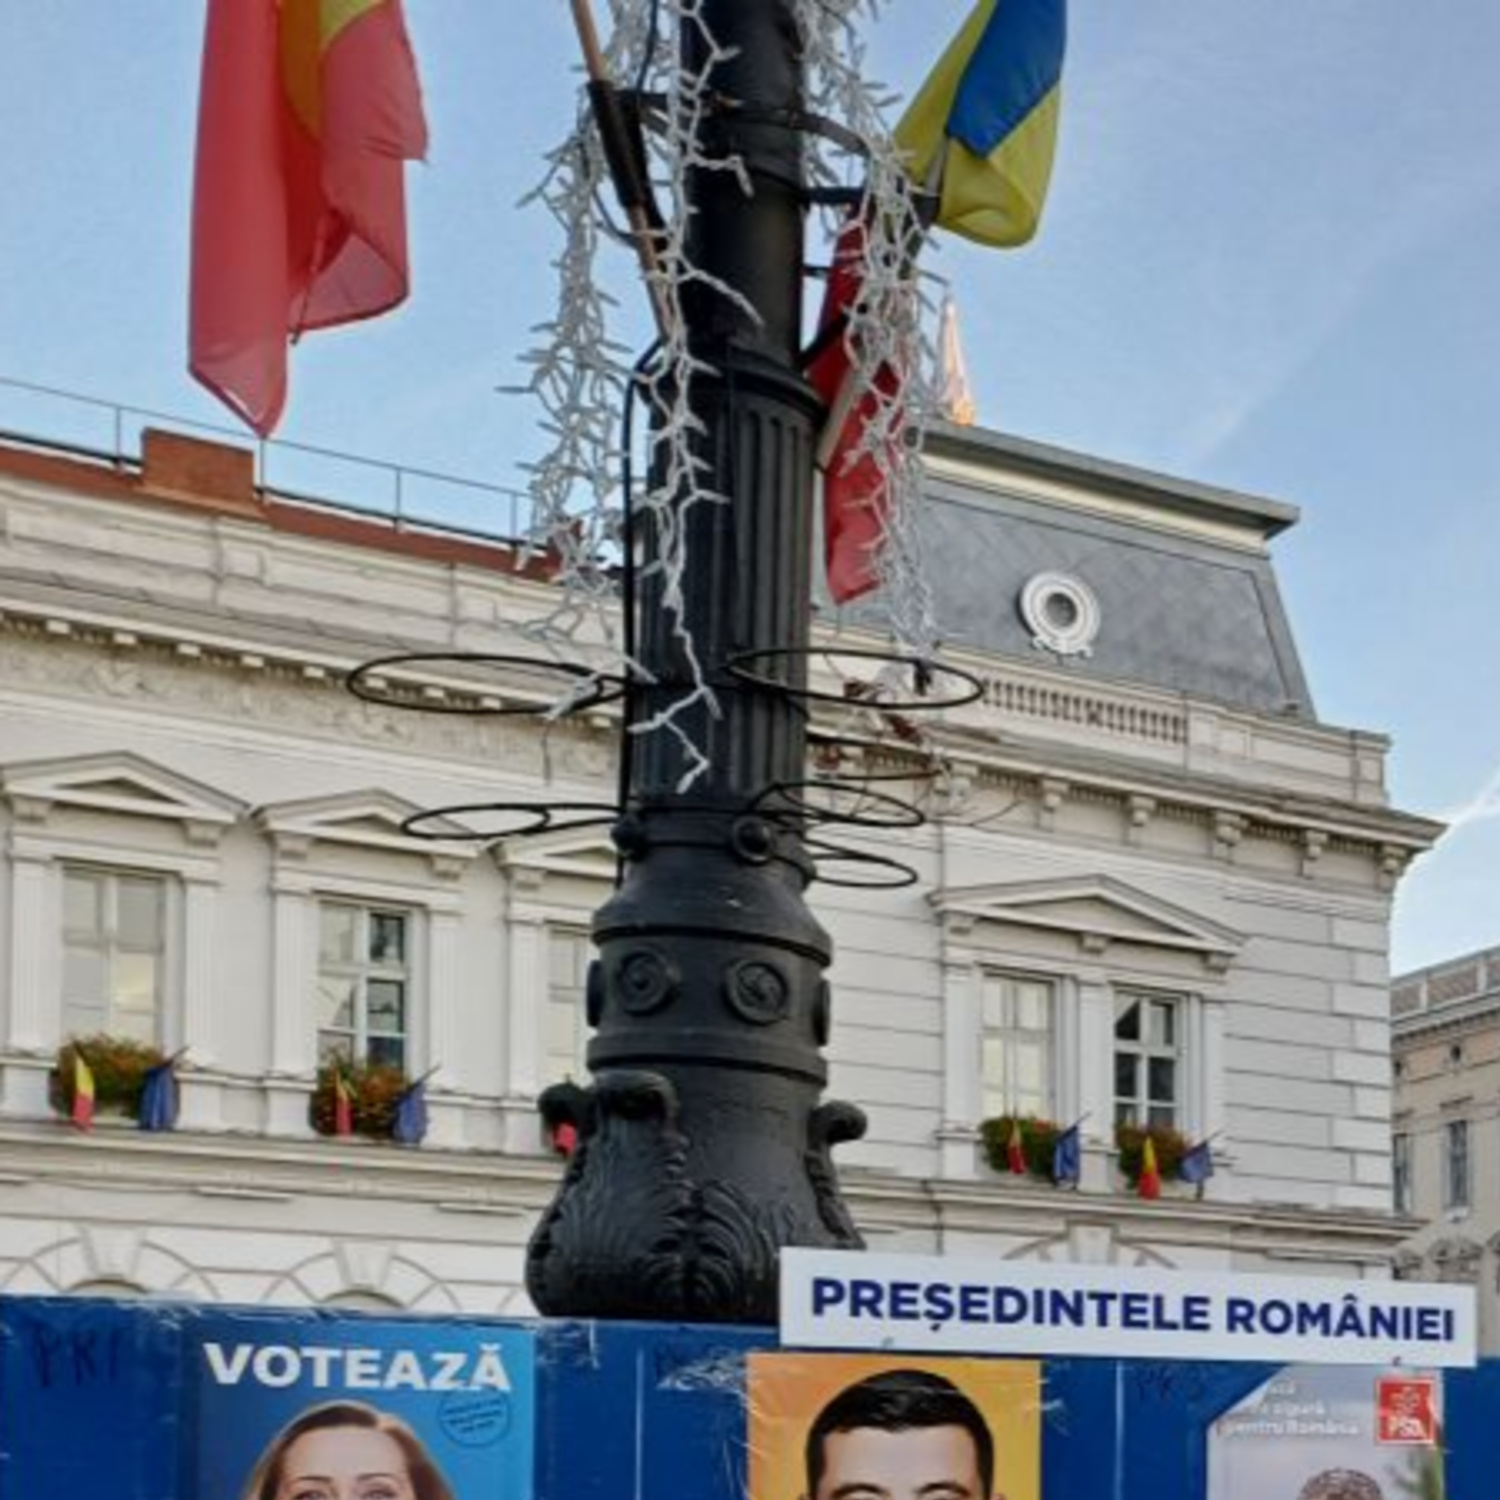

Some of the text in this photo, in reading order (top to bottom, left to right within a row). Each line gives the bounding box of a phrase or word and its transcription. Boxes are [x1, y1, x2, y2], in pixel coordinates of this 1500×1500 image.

[813, 1277, 1454, 1341] PREȘEDINTELE ROMÂNIEI
[203, 1342, 511, 1392] VOTEAZĂ
